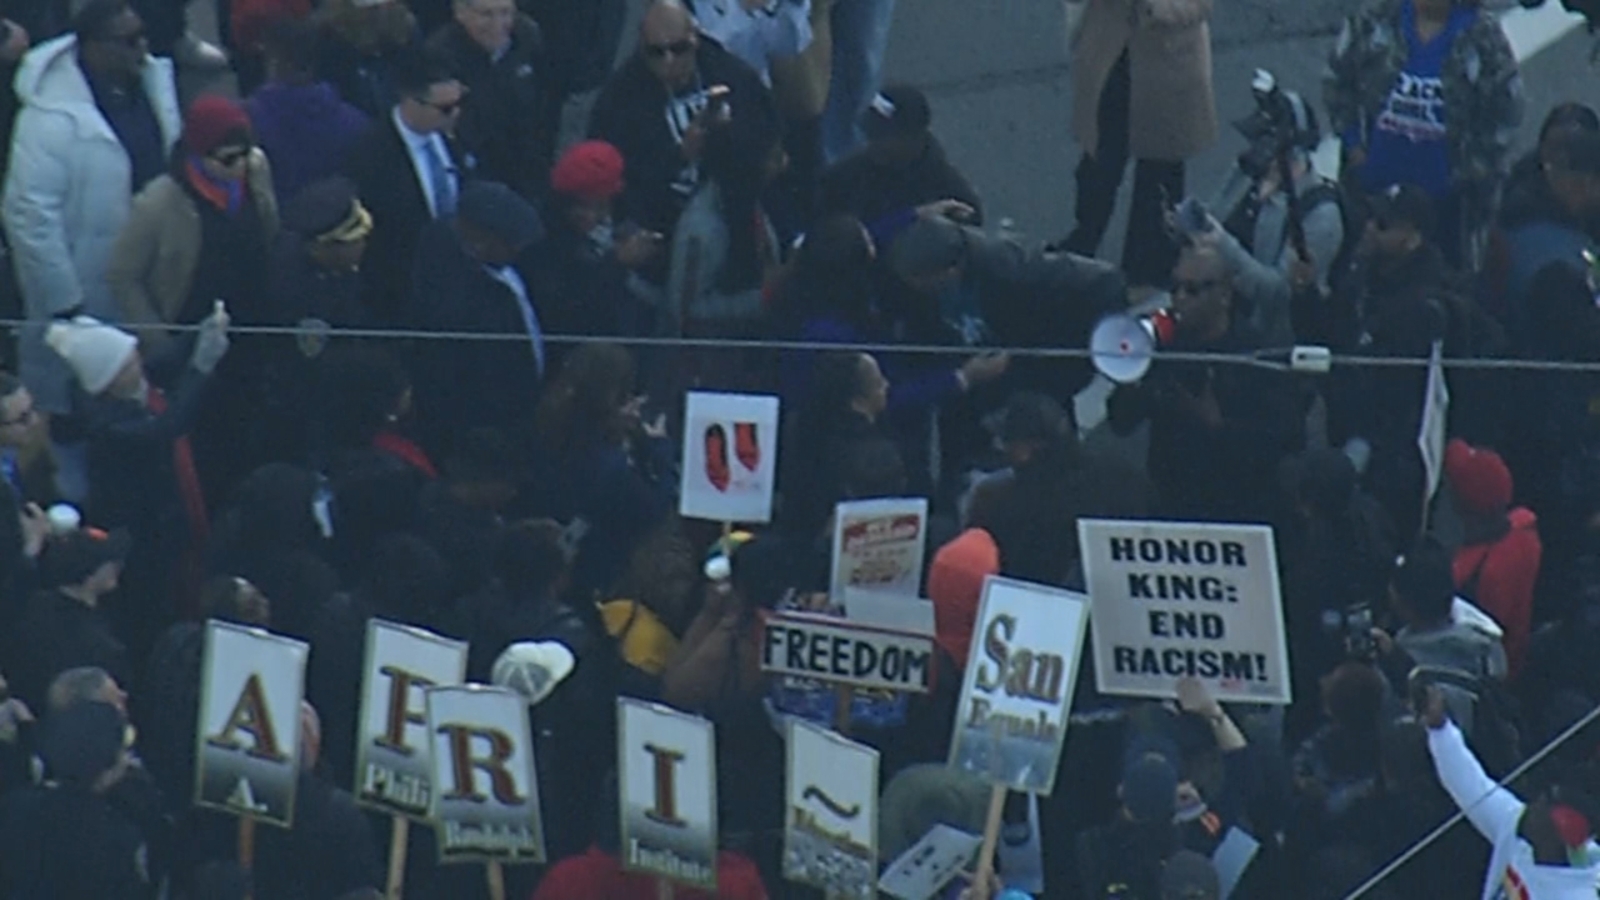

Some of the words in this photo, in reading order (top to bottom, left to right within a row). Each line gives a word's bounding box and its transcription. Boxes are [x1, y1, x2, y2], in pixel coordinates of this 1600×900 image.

[1109, 537, 1247, 566] HONOR
[1127, 573, 1239, 603] KING:
[1148, 610, 1225, 639] END
[764, 625, 931, 686] FREEDOM
[976, 613, 1065, 705] San
[1113, 646, 1268, 681] RACISM!
[206, 671, 288, 764] A
[436, 723, 528, 806] R
[643, 741, 688, 829] I
[226, 777, 267, 812] A.
